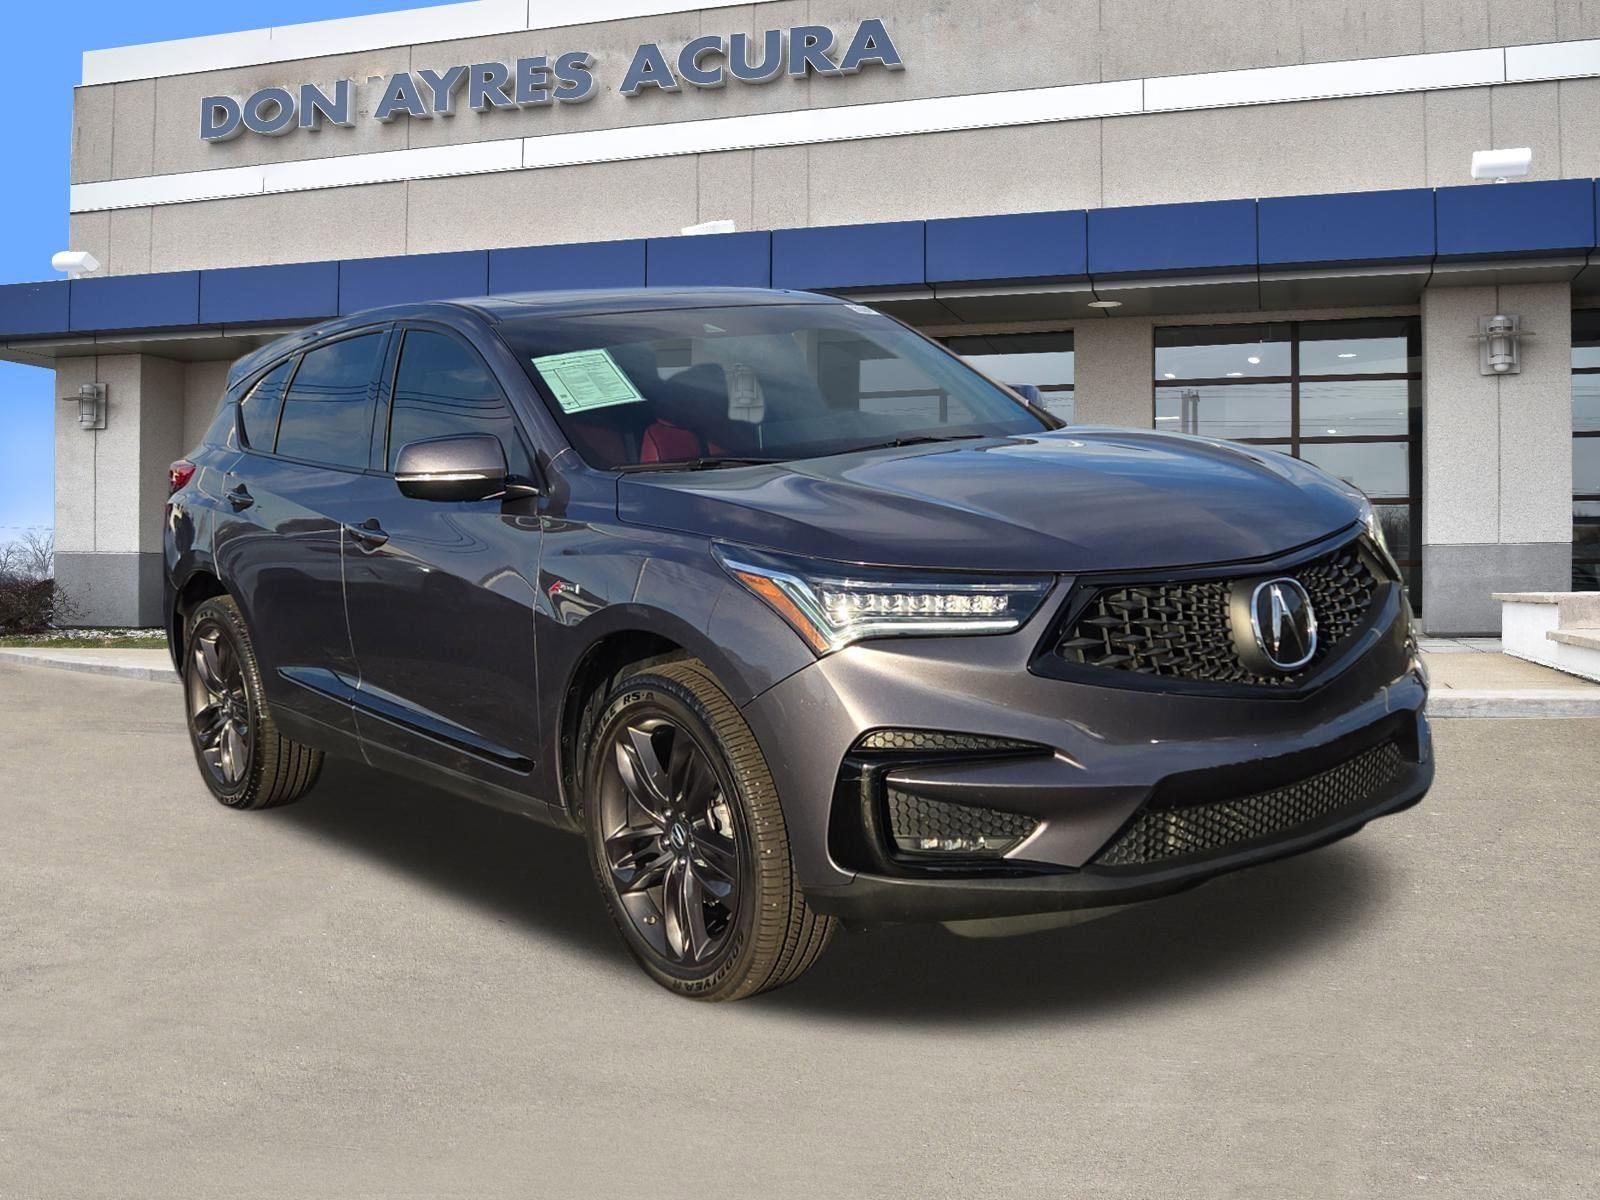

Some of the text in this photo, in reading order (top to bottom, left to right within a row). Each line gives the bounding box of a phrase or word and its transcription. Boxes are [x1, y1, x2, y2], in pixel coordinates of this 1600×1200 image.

[200, 18, 905, 143] DON AYRES ACURA
